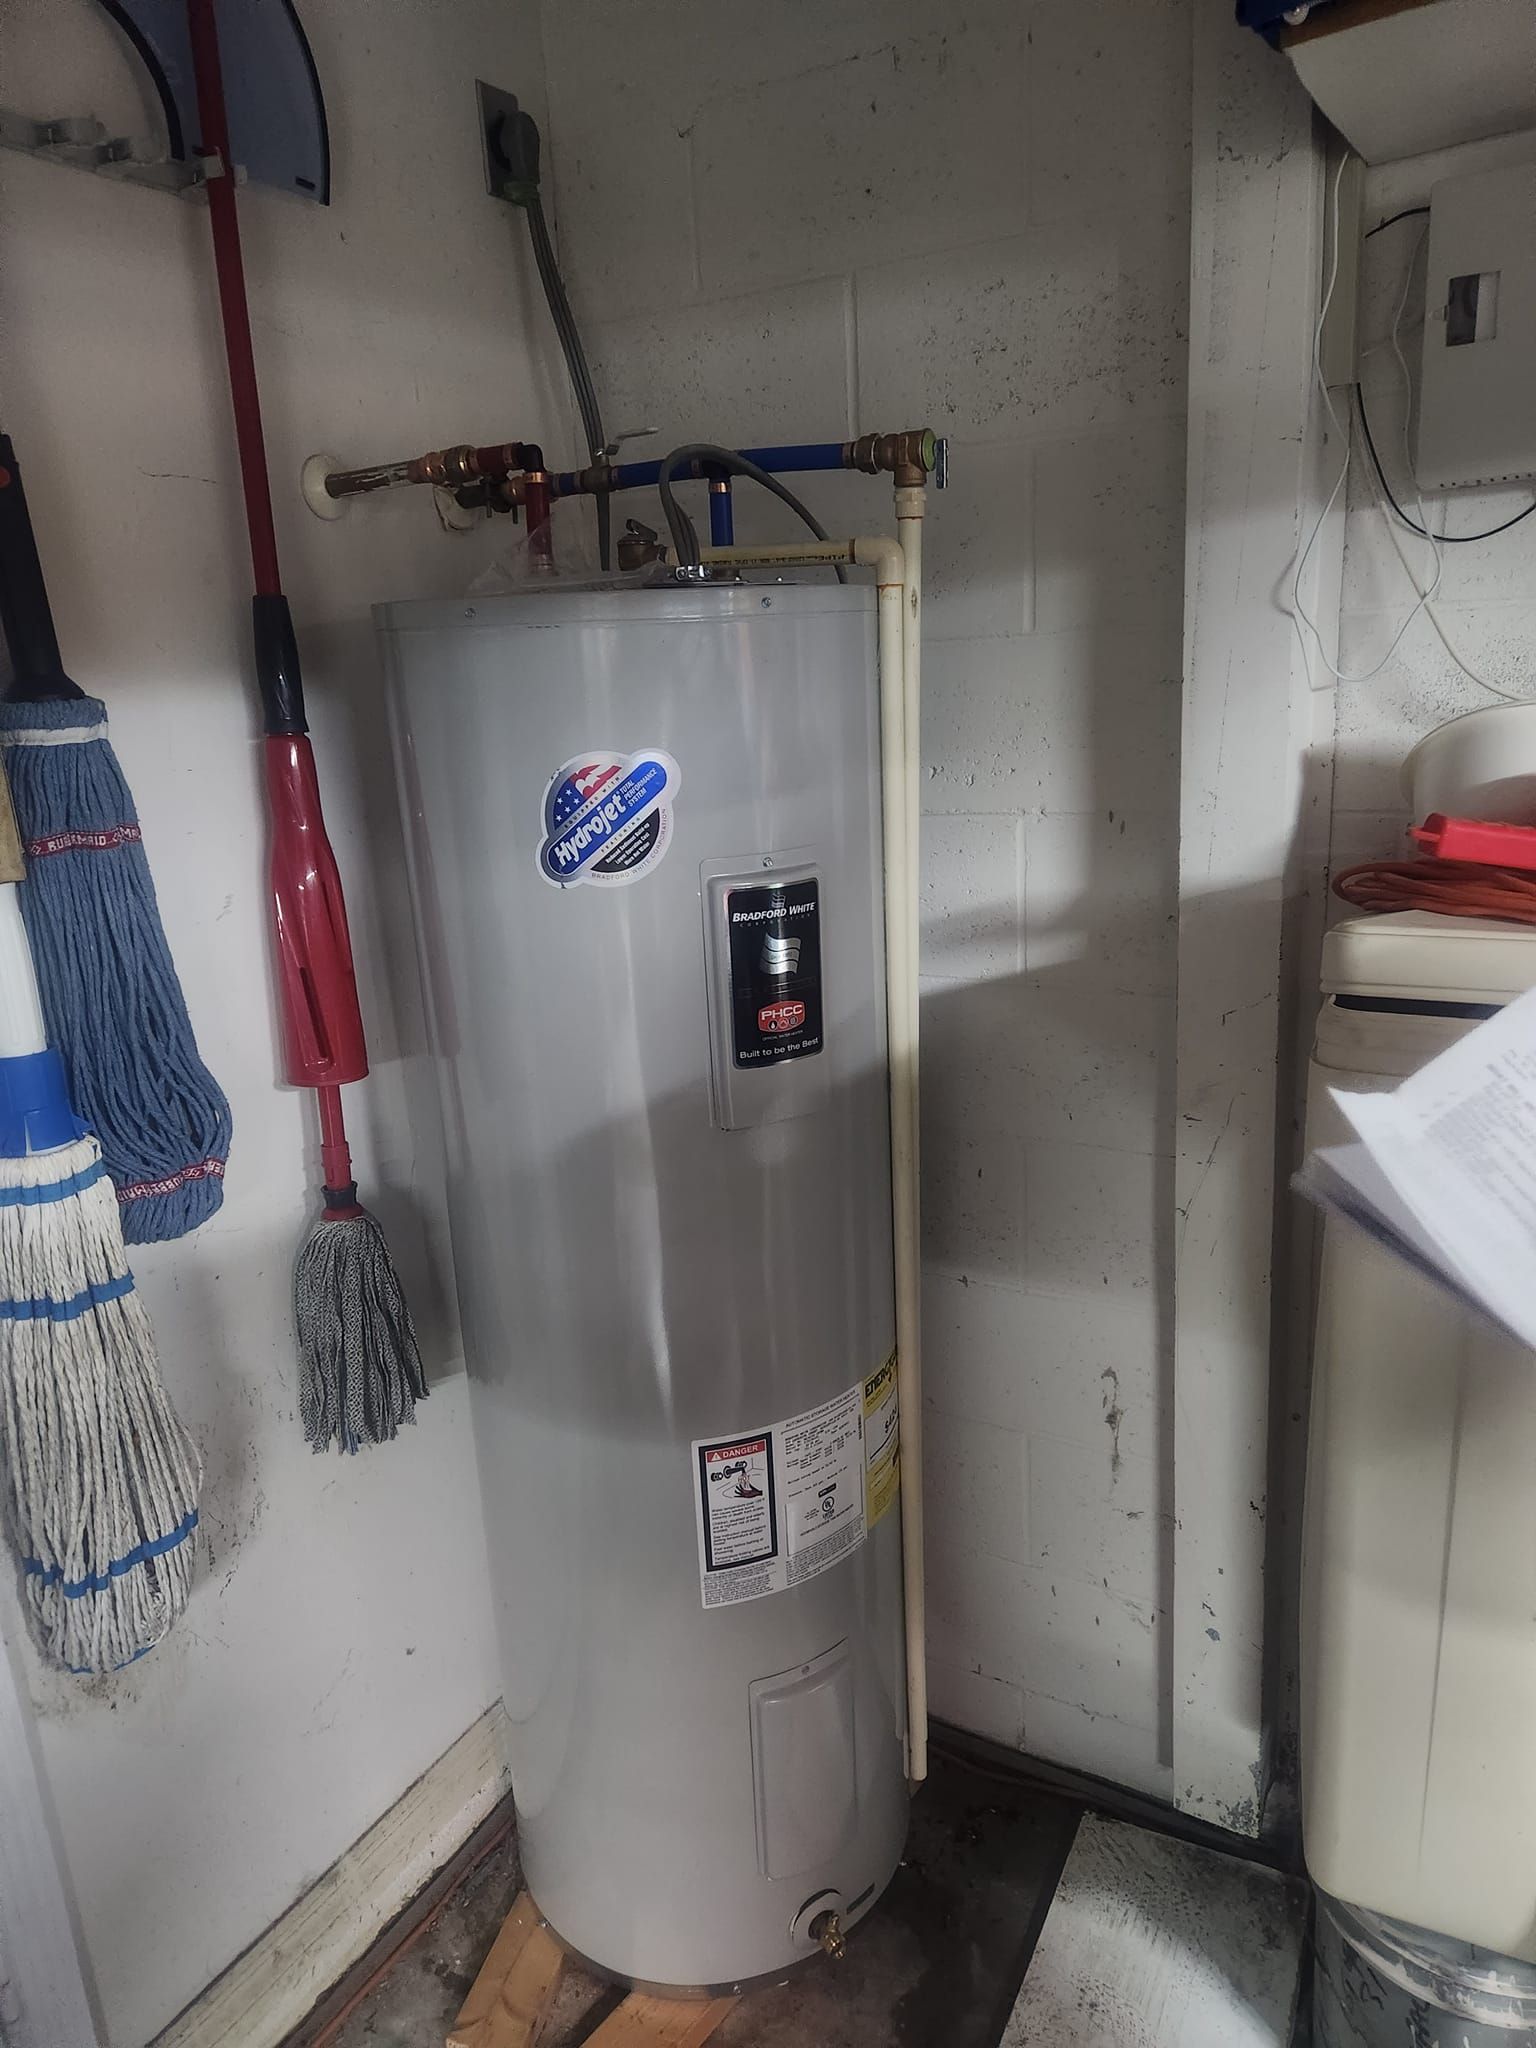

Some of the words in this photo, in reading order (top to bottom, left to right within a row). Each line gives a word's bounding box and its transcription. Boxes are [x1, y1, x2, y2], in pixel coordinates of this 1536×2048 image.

[601, 775, 620, 794] WITH
[619, 779, 635, 795] TOTAL
[623, 767, 658, 801] PERFORMANCE
[627, 786, 648, 807] SYSTEM
[553, 793, 627, 867] Hydrojet
[600, 817, 640, 853] FEATURING
[591, 871, 630, 881] BRADFORD
[632, 858, 651, 874] WHITE
[650, 808, 667, 859] CORPORATION
[732, 908, 787, 922] BRADFORD
[789, 901, 817, 915] WHITE
[761, 1004, 803, 1021] PHCC
[740, 1050, 760, 1059] Built
[774, 1046, 786, 1054] be
[787, 1043, 800, 1052] the
[801, 1037, 819, 1048] Best
[722, 1444, 759, 1459] DANGER
